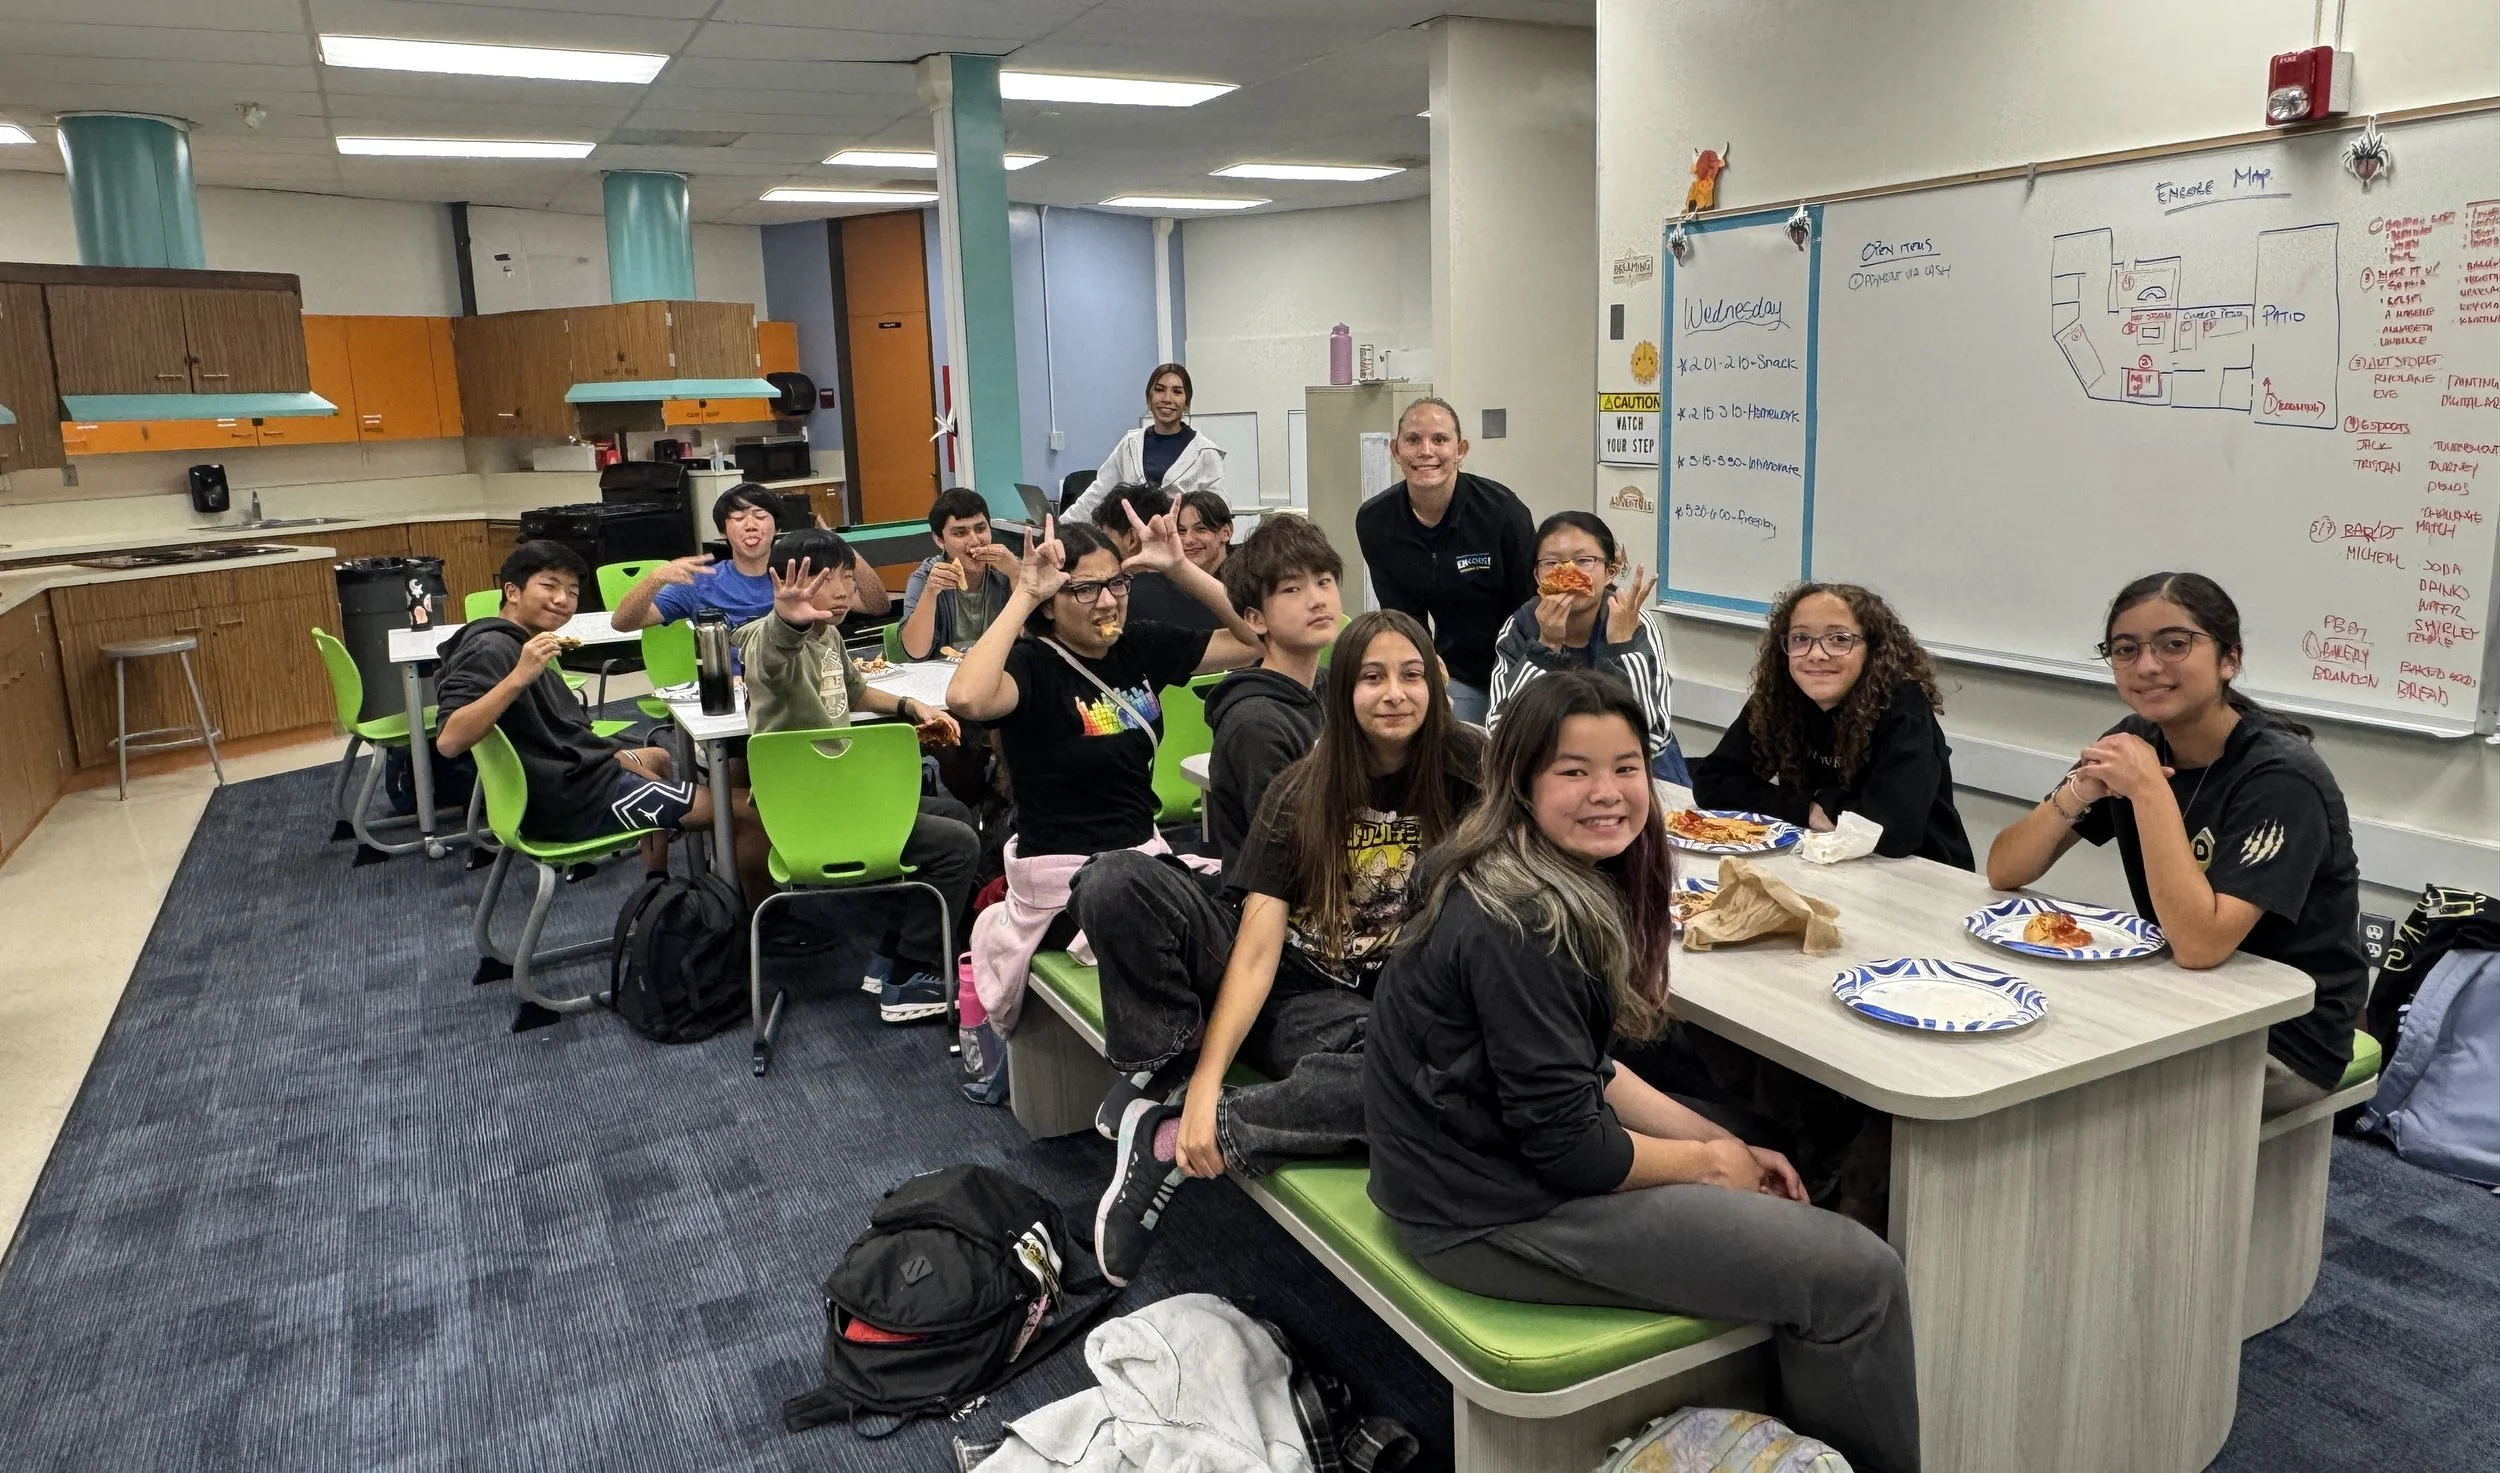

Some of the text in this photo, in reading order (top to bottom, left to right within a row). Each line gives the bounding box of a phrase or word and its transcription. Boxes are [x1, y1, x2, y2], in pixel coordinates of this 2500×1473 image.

[1684, 296, 1782, 332] Wednesday
[2263, 304, 2306, 327] PATIO
[1614, 396, 1660, 409] CAUTION
[1616, 416, 1644, 431] WATCH
[1607, 438, 1655, 453] YOUR STEP
[2356, 438, 2392, 451] JACK
[2354, 459, 2401, 474] TRISTAN
[2312, 665, 2379, 689] BRANDON
